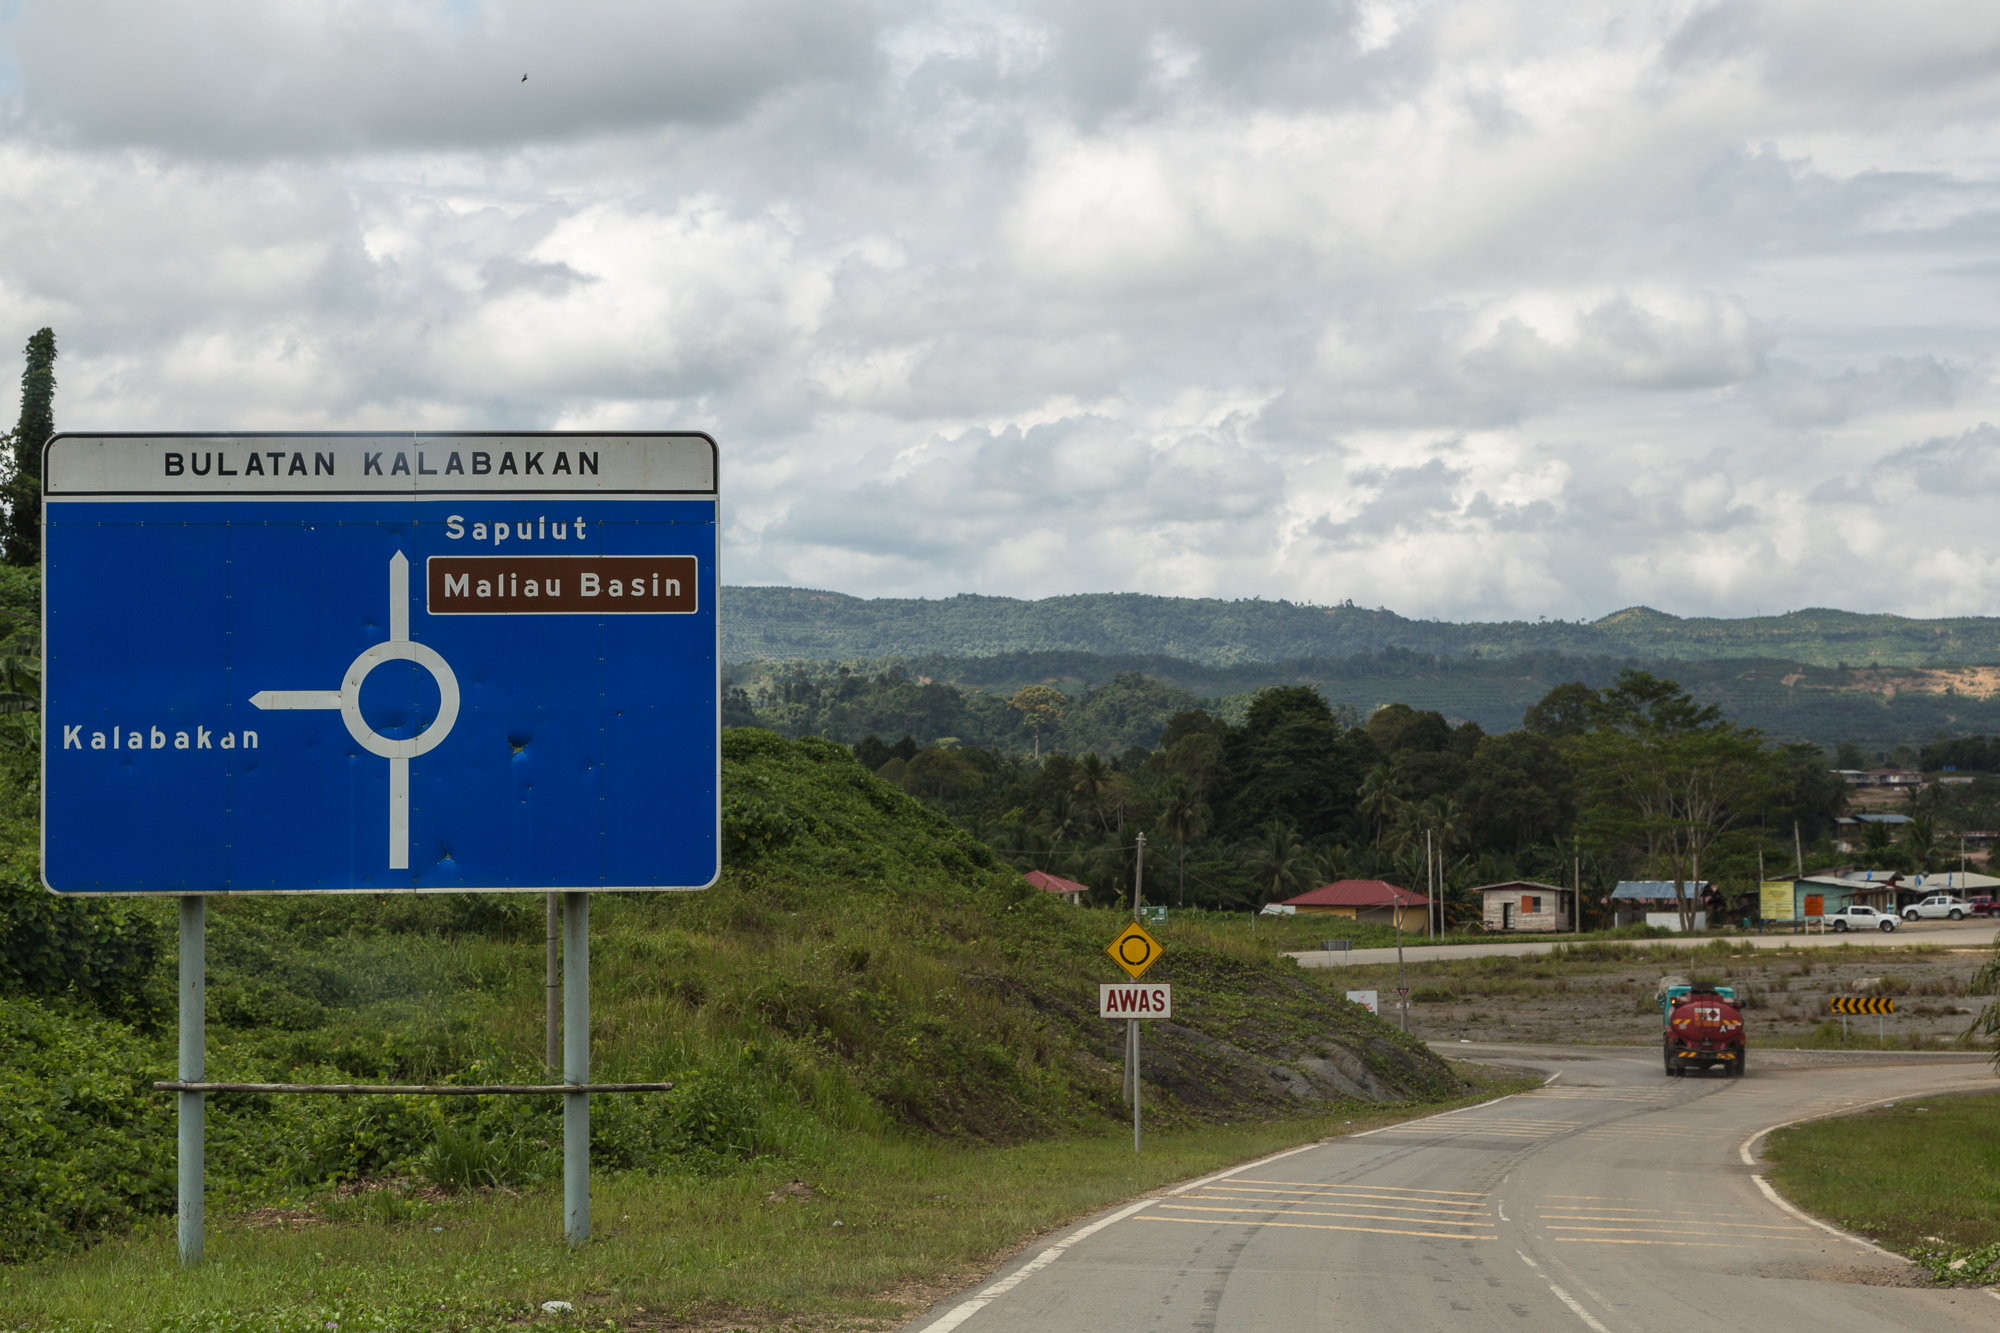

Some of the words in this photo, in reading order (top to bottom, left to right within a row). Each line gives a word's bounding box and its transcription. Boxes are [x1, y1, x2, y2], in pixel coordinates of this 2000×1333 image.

[165, 452, 335, 476] BULATAN
[363, 451, 599, 476] KALABAKAN
[445, 515, 586, 546] Sapulut
[444, 572, 560, 597] Maliau
[580, 572, 681, 597] Basin
[63, 725, 258, 749] Kalabakan
[1106, 989, 1166, 1013] AWAS
[1719, 1025, 1727, 1033] A
